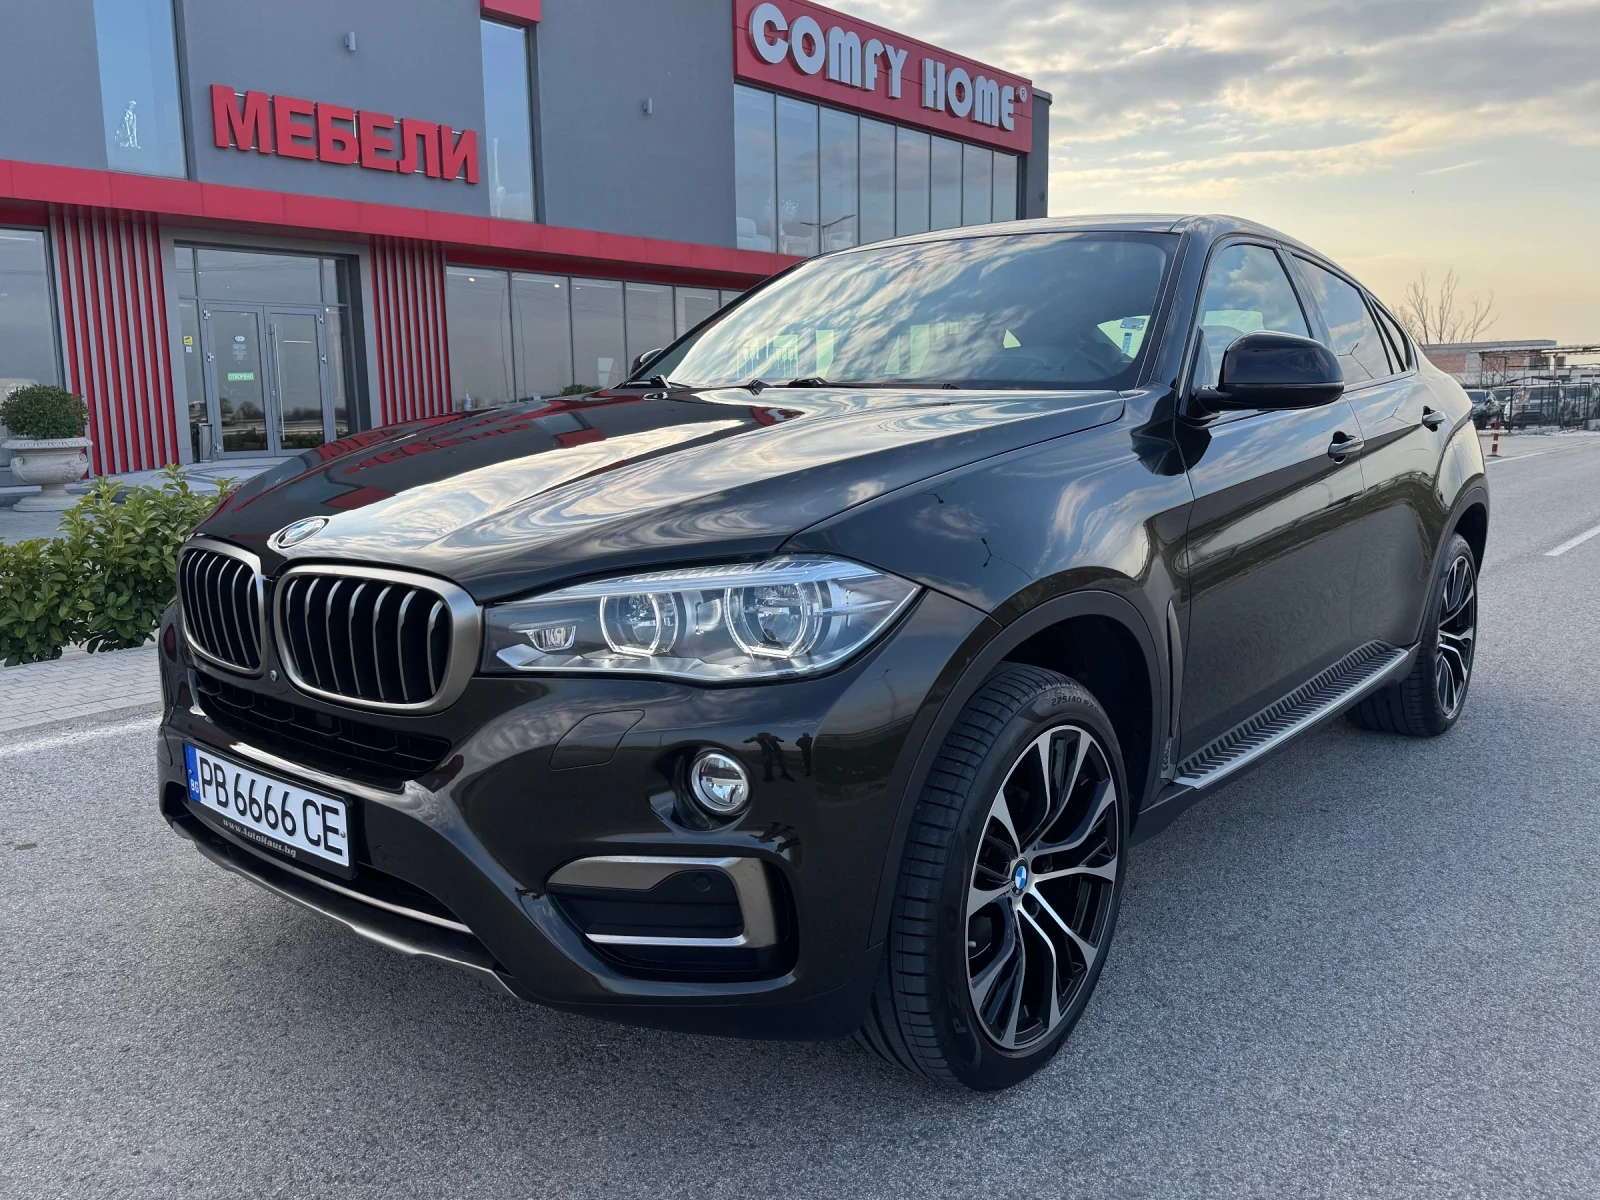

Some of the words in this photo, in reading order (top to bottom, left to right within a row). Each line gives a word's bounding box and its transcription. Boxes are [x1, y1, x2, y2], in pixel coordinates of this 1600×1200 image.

[749, 2, 908, 99] COMFY
[210, 83, 480, 184] МЕБЕЛИ
[1051, 695, 1082, 706] 275/40
[190, 778, 200, 794] BG
[222, 819, 297, 858] www.AutoHaus.bg
